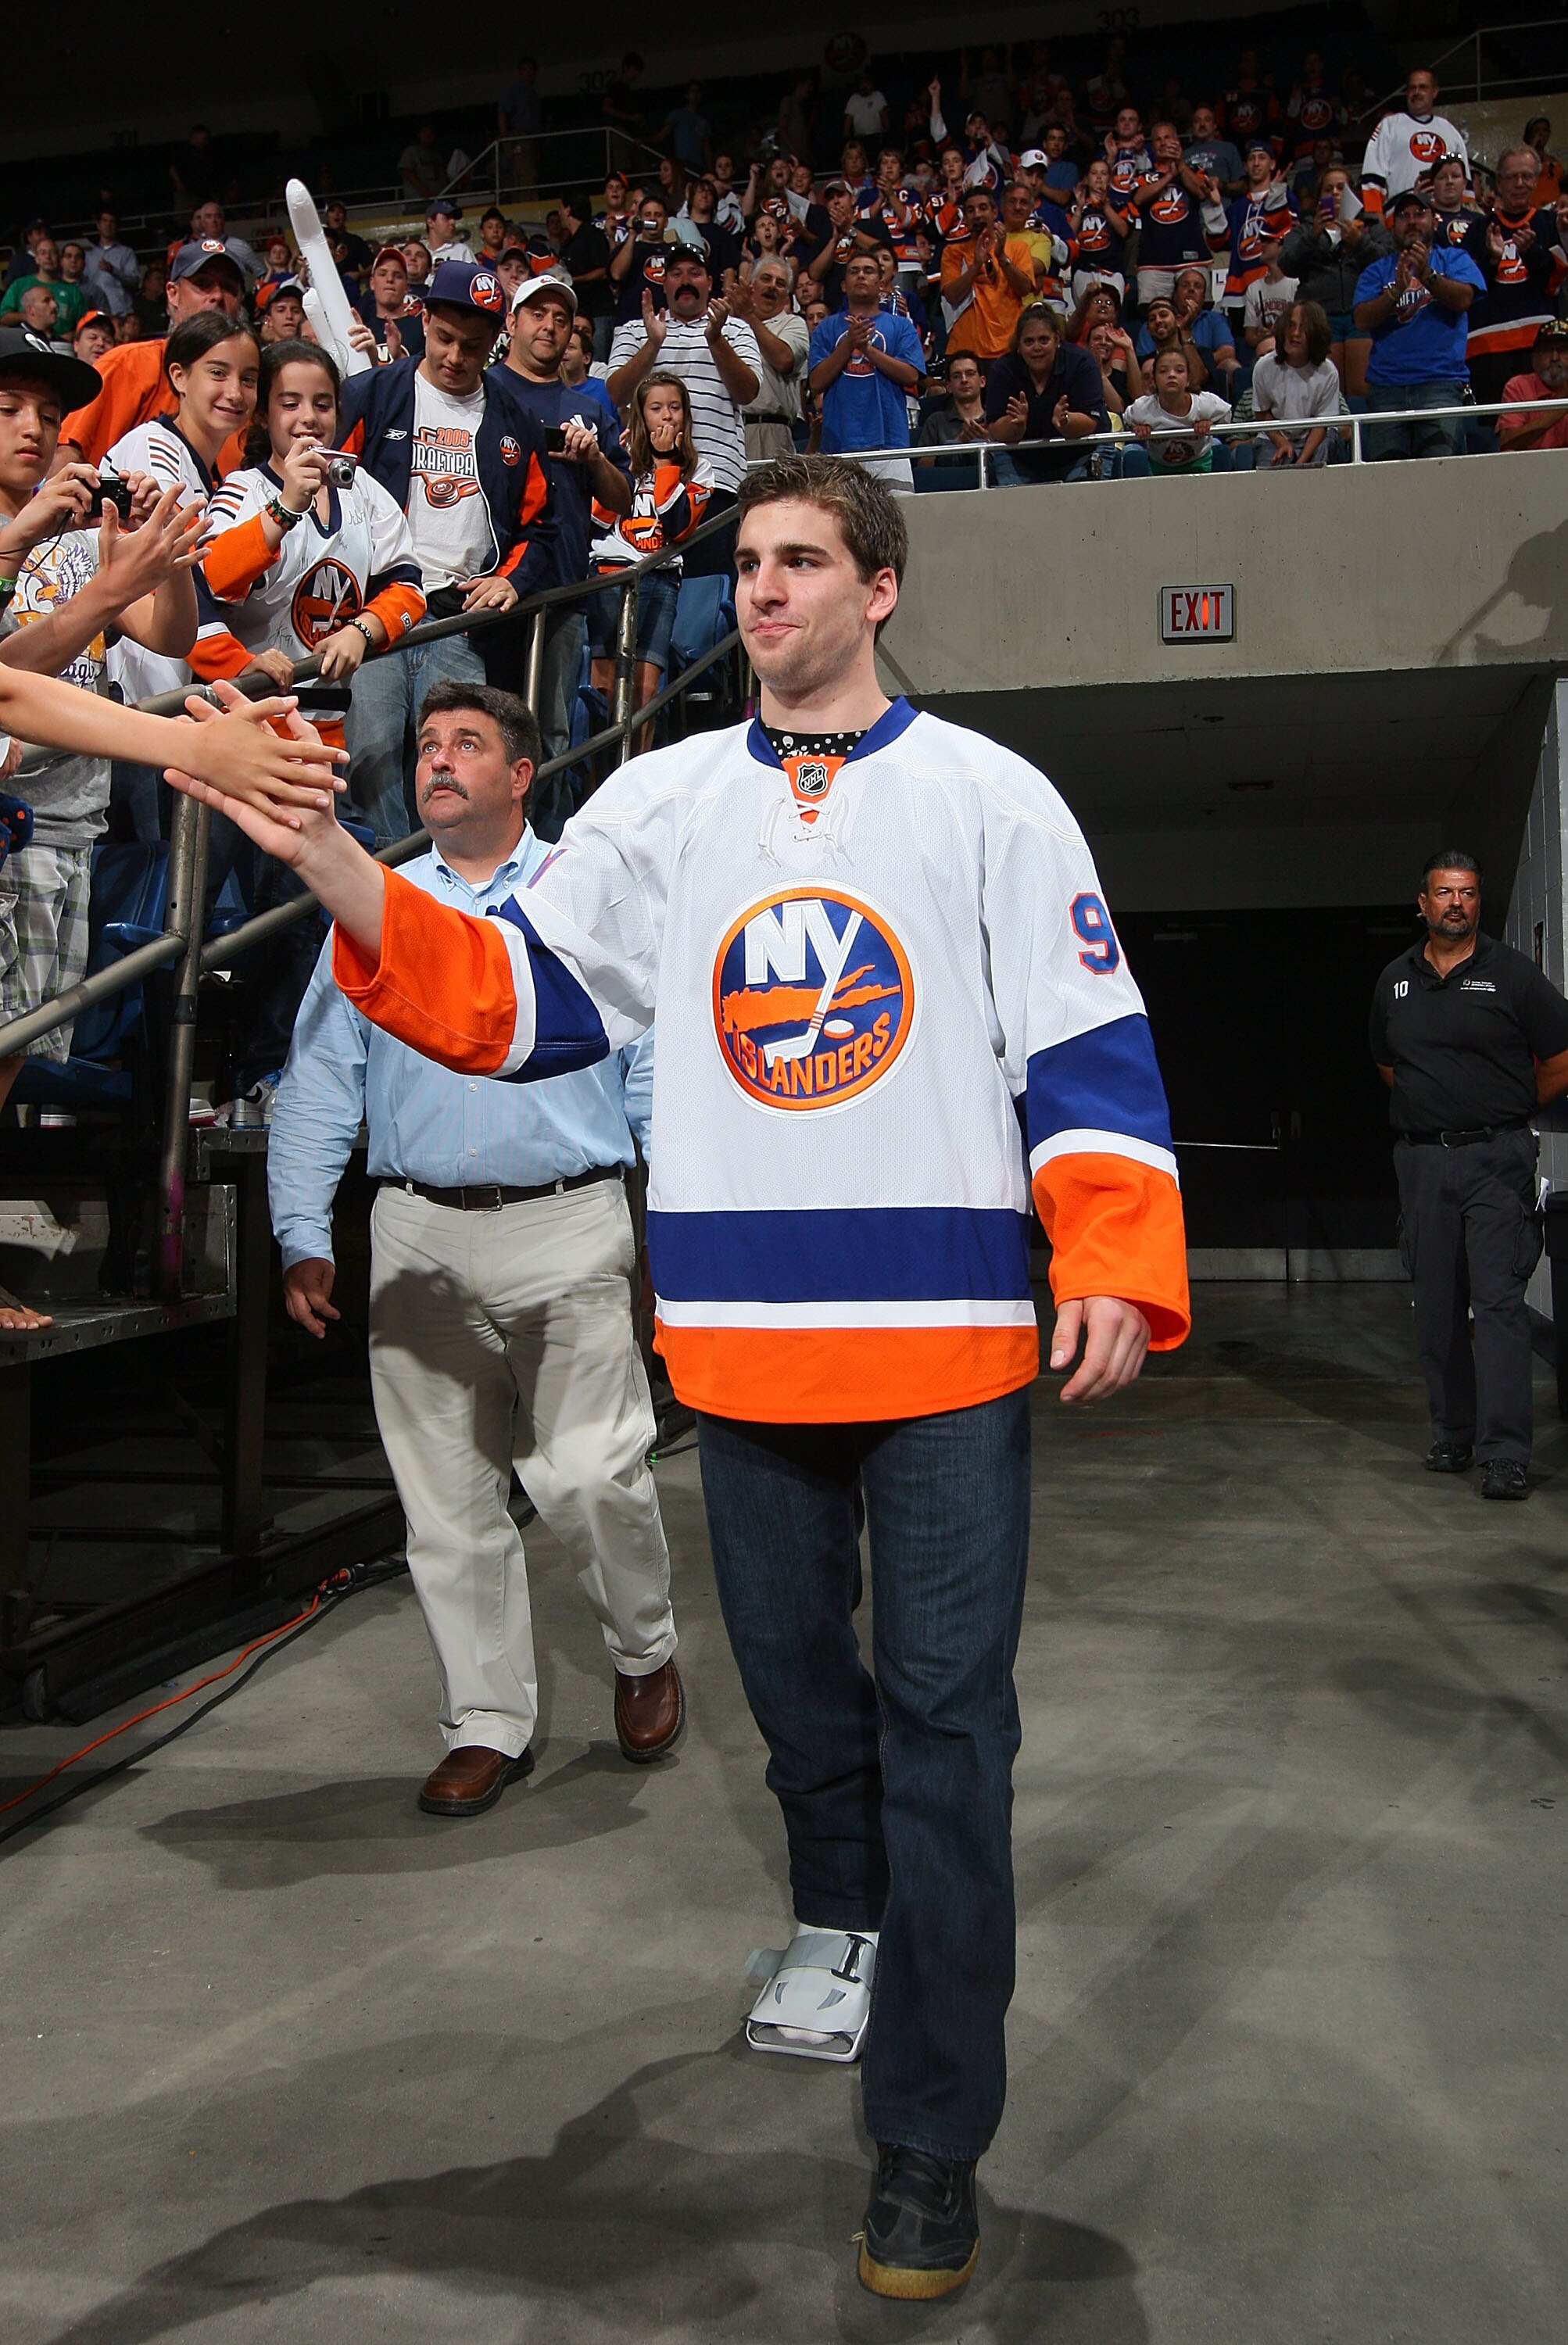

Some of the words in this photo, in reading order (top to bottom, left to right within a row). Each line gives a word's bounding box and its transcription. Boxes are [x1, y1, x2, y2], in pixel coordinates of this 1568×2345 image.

[1097, 6, 1139, 34] 303
[899, 189, 909, 202] C
[930, 196, 944, 207] 91
[435, 428, 471, 447] 2009
[1171, 591, 1225, 632] EXIT
[804, 770, 822, 789] NHL
[1394, 980, 1409, 1000] 10
[731, 1011, 891, 1097] ISLANDERS
